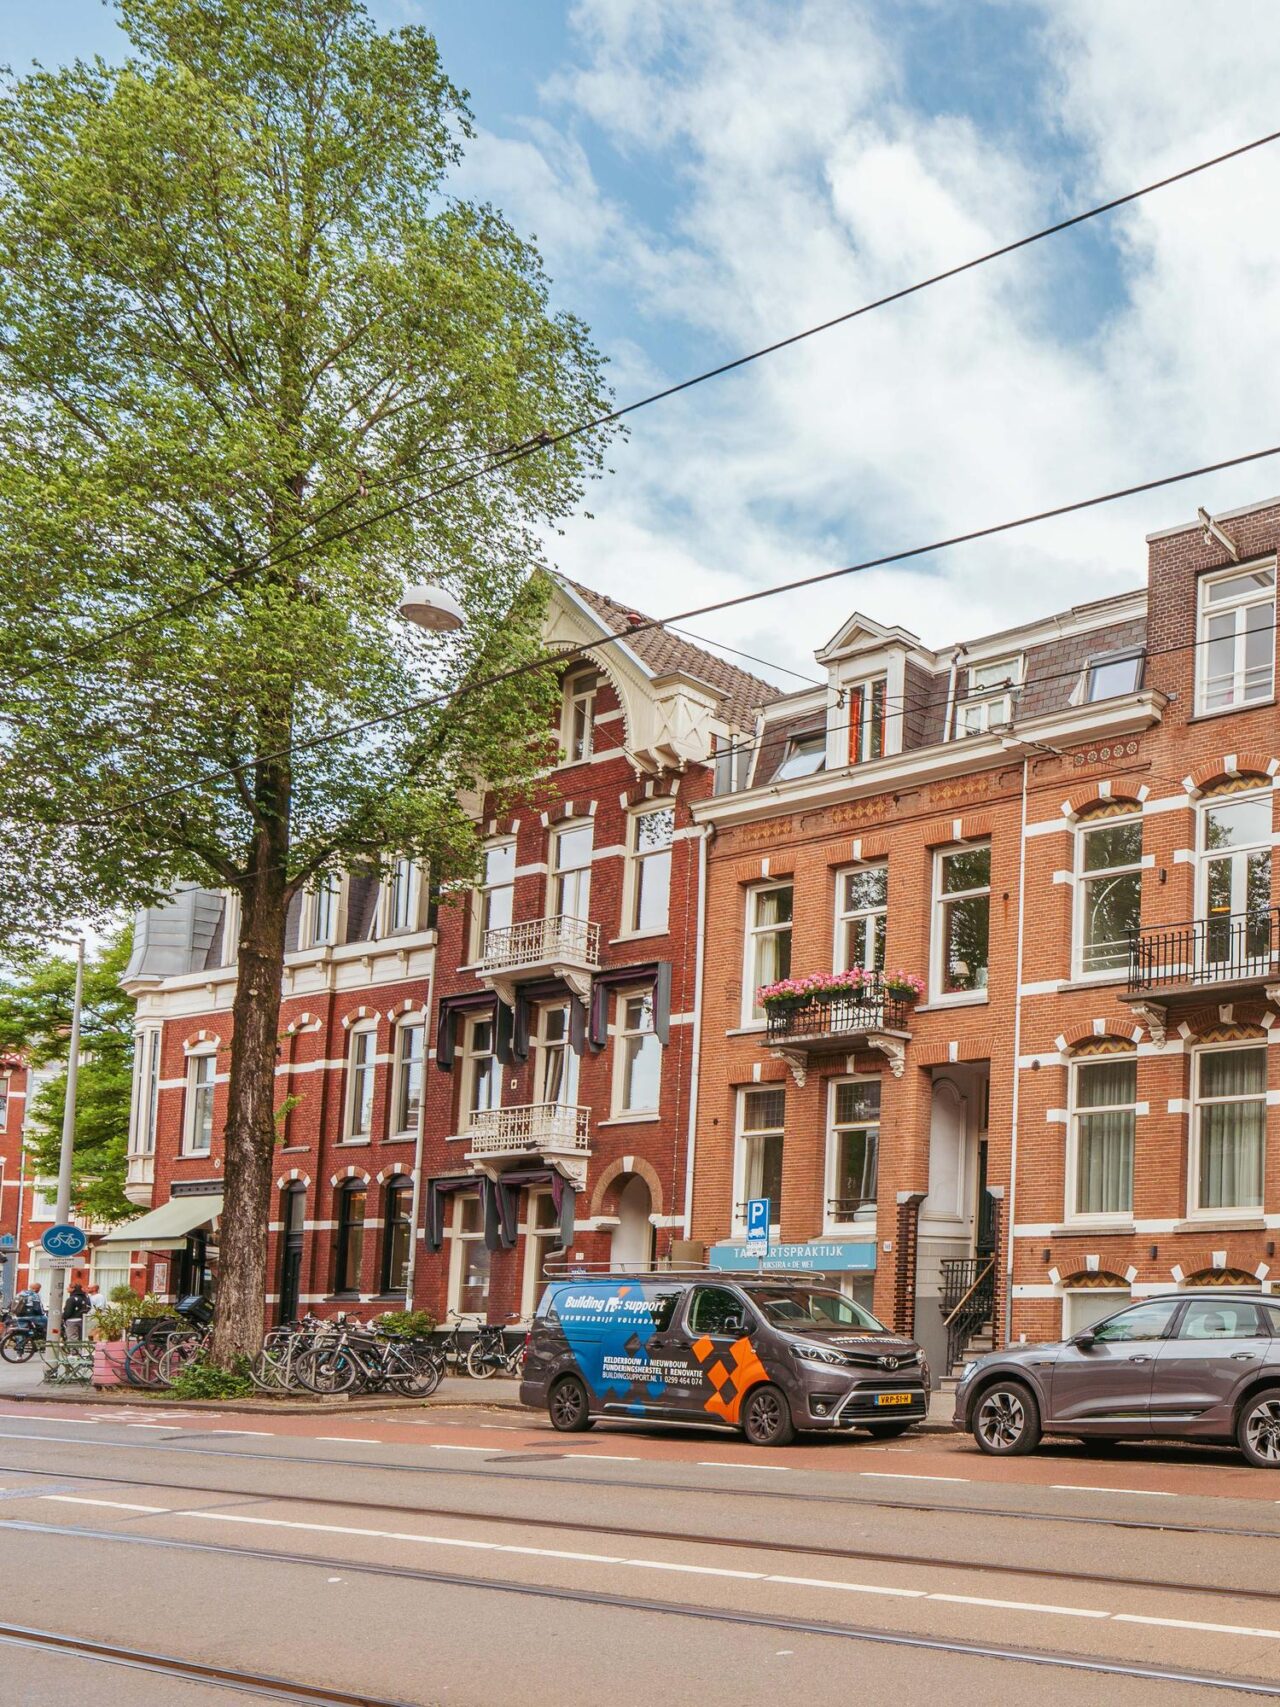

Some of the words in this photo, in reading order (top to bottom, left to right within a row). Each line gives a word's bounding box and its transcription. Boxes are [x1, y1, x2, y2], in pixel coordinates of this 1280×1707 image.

[752, 1203, 764, 1224] P
[565, 1295, 605, 1312] Building
[623, 1299, 666, 1313] support
[617, 1316, 660, 1325] VOLENDAM
[603, 1356, 642, 1366] KELDERBOUW
[649, 1359, 688, 1368] NIEUWBOUW
[602, 1363, 662, 1375] FUNDERINGSHERSTEL
[670, 1369, 703, 1377] RENOVATIE
[602, 1371, 658, 1382] BUILDINGSUPPORT.NL
[664, 1375, 678, 1384] 0299
[679, 1376, 690, 1384] 464
